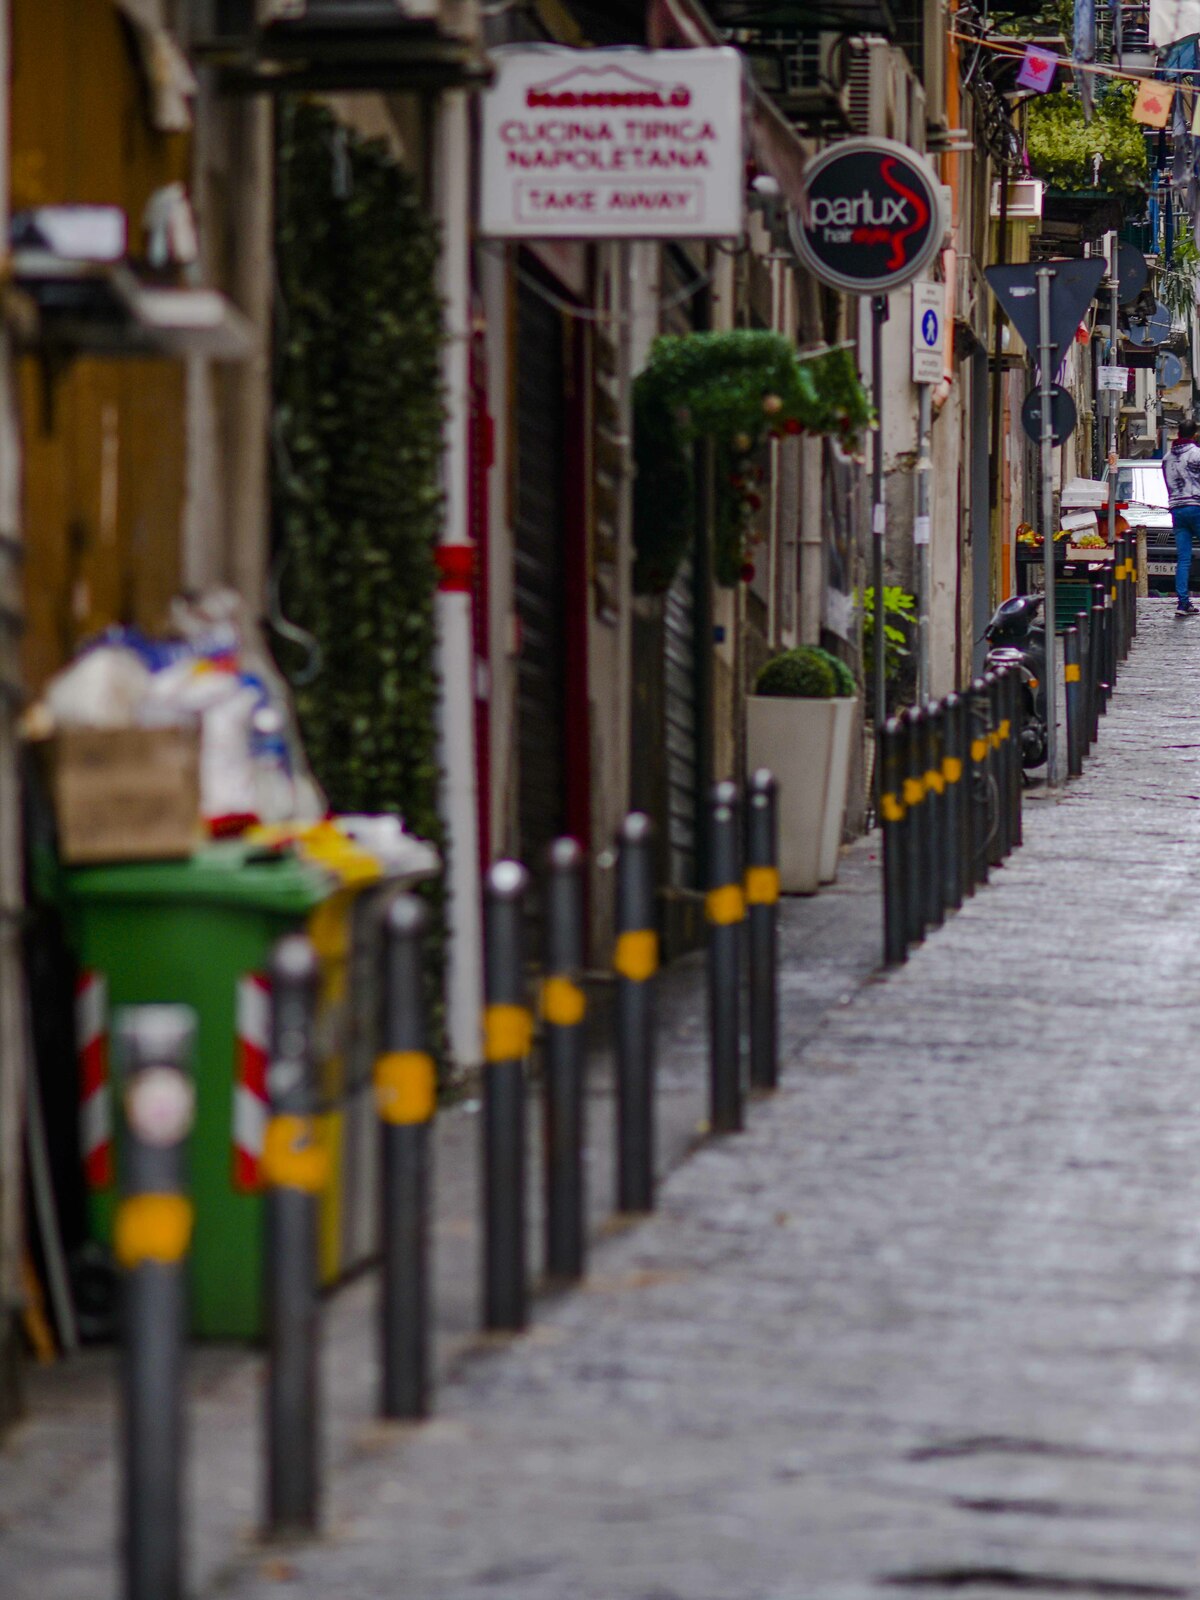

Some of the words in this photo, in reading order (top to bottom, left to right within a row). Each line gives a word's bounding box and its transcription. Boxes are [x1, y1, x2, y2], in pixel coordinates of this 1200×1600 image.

[500, 120, 613, 143] CUCINA
[625, 119, 718, 143] TIPICA
[507, 149, 709, 170] NAPOLETANA
[529, 190, 597, 210] TAKE
[608, 190, 691, 210] AWAY
[810, 189, 909, 233] parlux
[824, 226, 853, 243] hair
